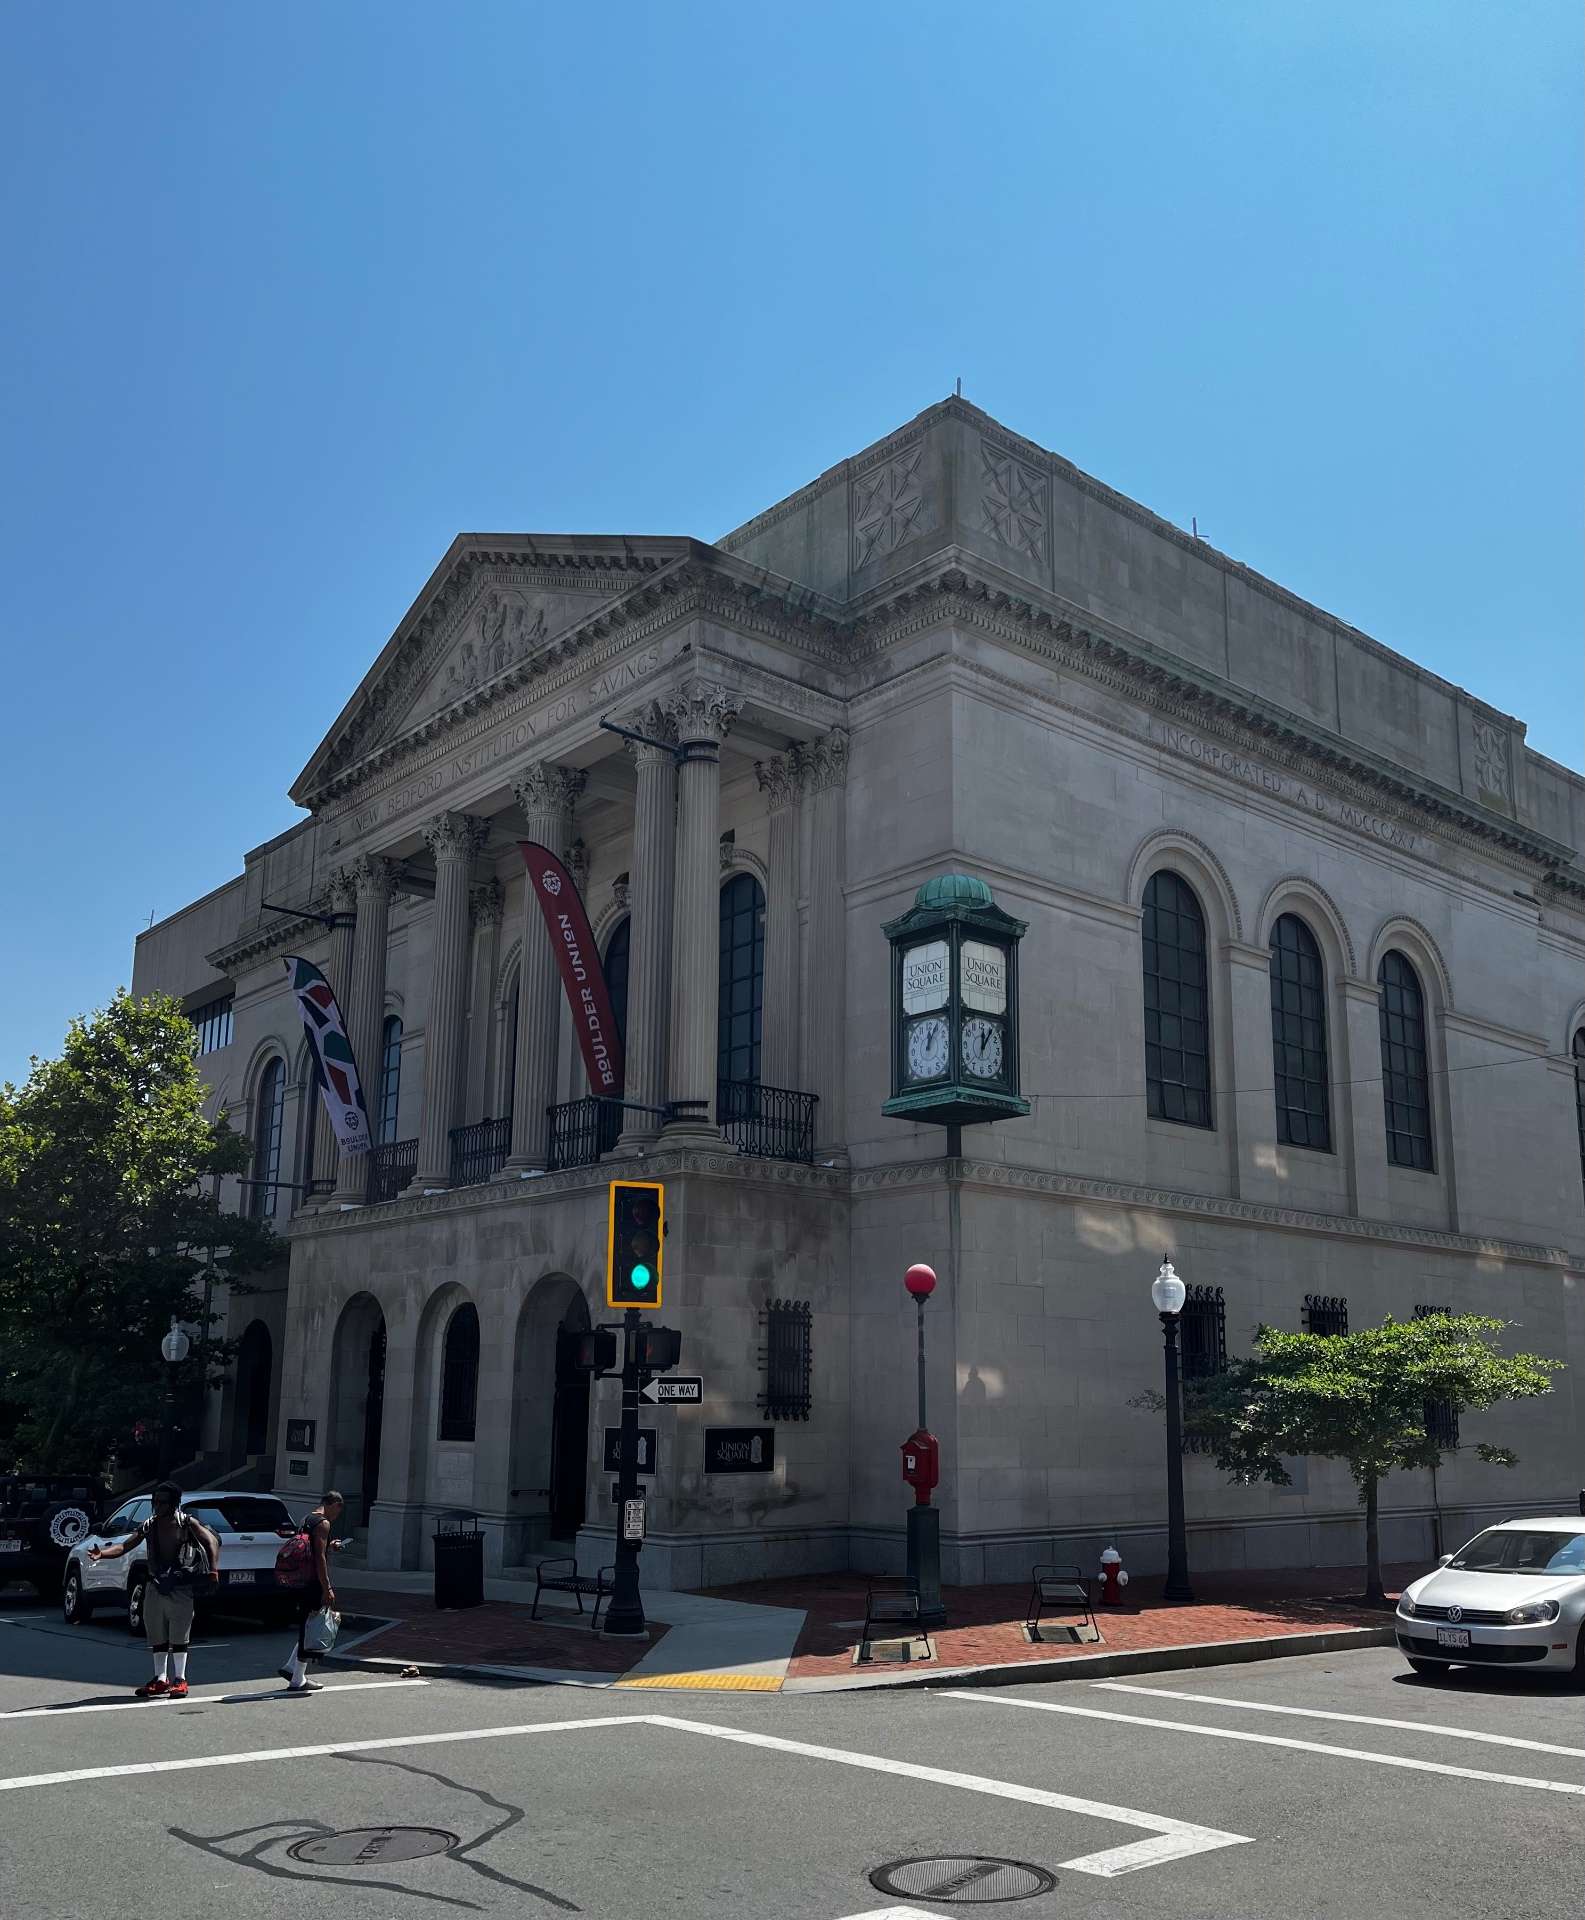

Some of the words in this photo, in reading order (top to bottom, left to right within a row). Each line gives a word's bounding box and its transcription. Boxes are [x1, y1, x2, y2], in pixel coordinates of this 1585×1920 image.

[354, 805, 380, 831] NEW
[387, 771, 443, 816] BEDFORD
[452, 717, 537, 781] INSTITUTION
[547, 696, 577, 728] FOR
[588, 647, 658, 704] SAVINGS
[1163, 726, 1281, 792] INCORPORATED
[557, 913, 588, 982] UNION
[910, 959, 942, 978] UNION
[967, 958, 999, 976] UNION
[907, 972, 945, 990] SQUARE
[965, 970, 1001, 990] SQUARE
[581, 986, 614, 1086] BOULDER
[341, 1134, 368, 1145] BOULDER
[658, 1385, 676, 1397] ONE
[678, 1385, 696, 1397] WAY
[720, 1441, 750, 1451] UNION
[717, 1449, 750, 1462] SQUARE
[1439, 1633, 1457, 1643] 1LYS
[1458, 1634, 1467, 1644] 66
